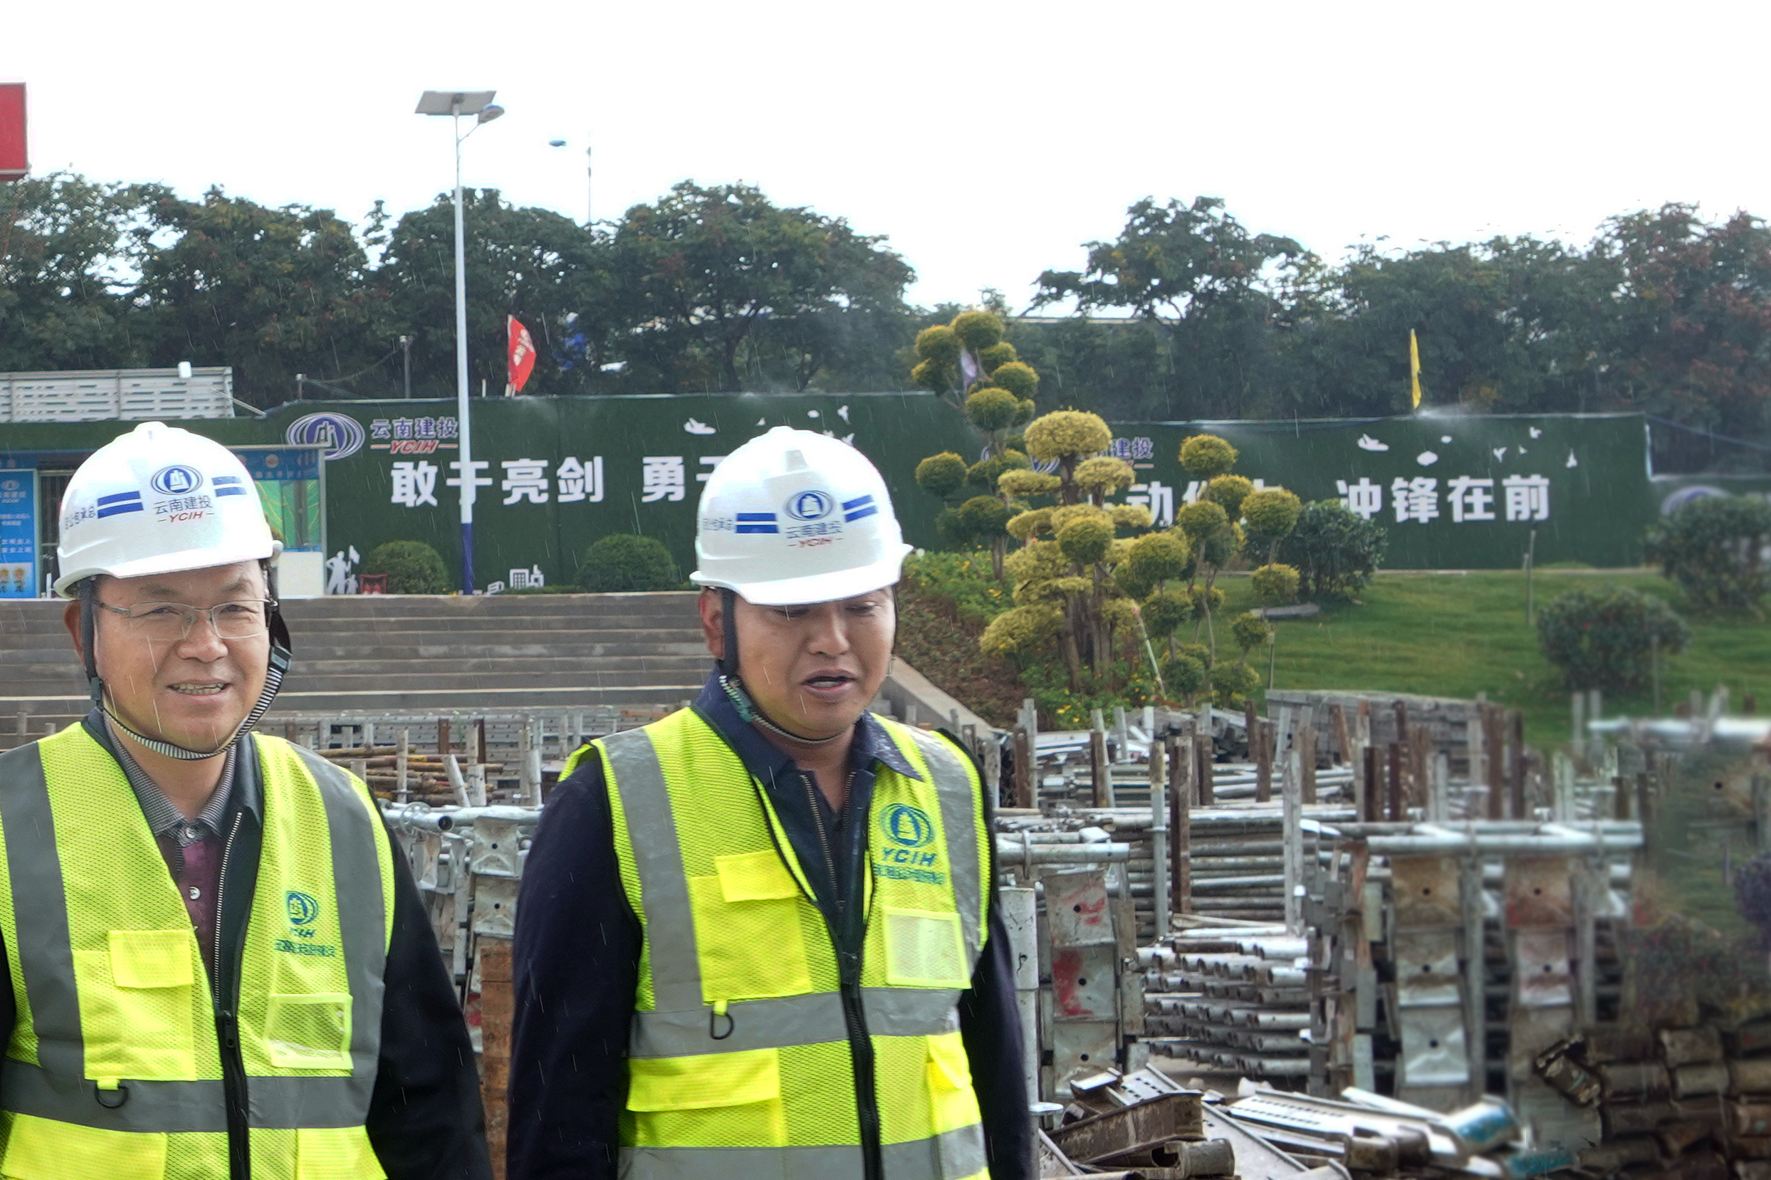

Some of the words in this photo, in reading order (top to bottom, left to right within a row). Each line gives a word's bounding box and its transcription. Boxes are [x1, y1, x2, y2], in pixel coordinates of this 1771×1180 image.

[369, 416, 459, 439] 云南建投
[389, 439, 440, 455] YCIH
[1096, 437, 1153, 460] 建投
[390, 456, 604, 508] 敢于亮剑
[1336, 474, 1551, 524] 冲锋在前
[153, 494, 213, 515] 云南建投
[169, 510, 203, 523] YCIH
[785, 520, 843, 540] 云南建投
[882, 847, 938, 868] YCIH
